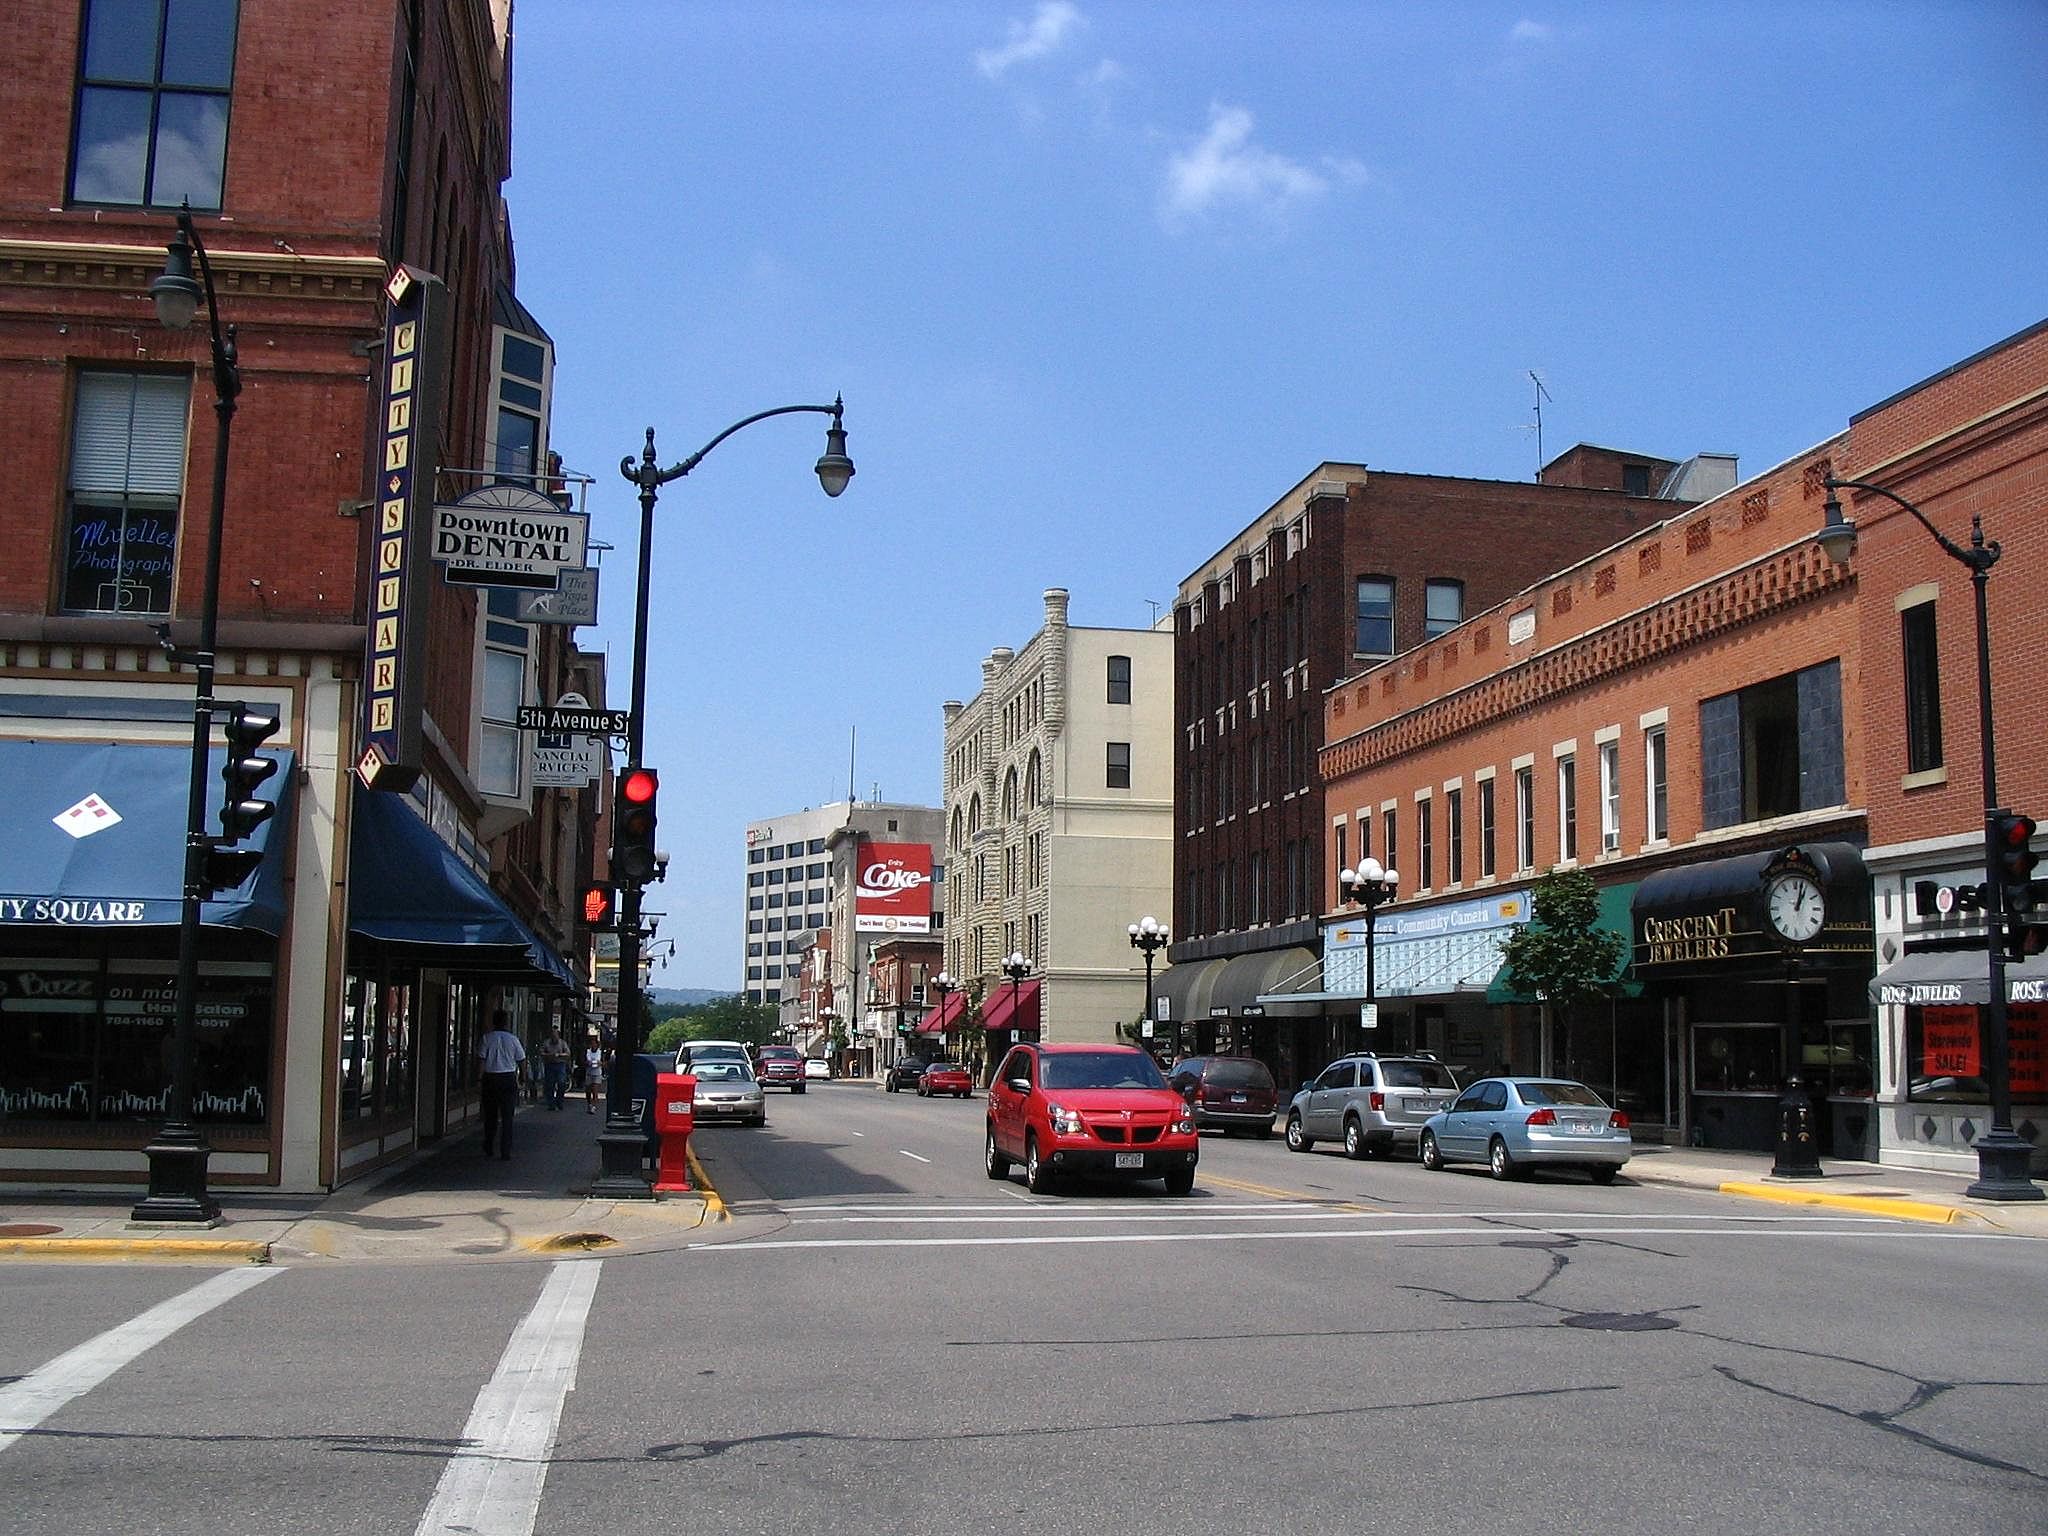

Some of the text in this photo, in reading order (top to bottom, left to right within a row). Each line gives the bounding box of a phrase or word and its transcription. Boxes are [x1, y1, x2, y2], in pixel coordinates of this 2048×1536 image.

[376, 327, 412, 727] CITY SQUARE
[440, 513, 568, 543] Downtown
[438, 531, 570, 562] DENTAL
[520, 709, 624, 731] 5th Avenue S
[533, 752, 592, 762] NANCIAL
[534, 762, 589, 773] RVICES
[864, 863, 922, 888] Coke
[0, 899, 145, 924] TY SQUARE
[1397, 914, 1449, 935] Community
[1451, 910, 1489, 926] Camera
[1644, 907, 1736, 943] CRESCENT
[1649, 938, 1729, 964] JEWELERS
[110, 987, 178, 999] on mai
[1881, 984, 1962, 1003] ROSE JEWELERS
[2010, 981, 2044, 1000] ROSE
